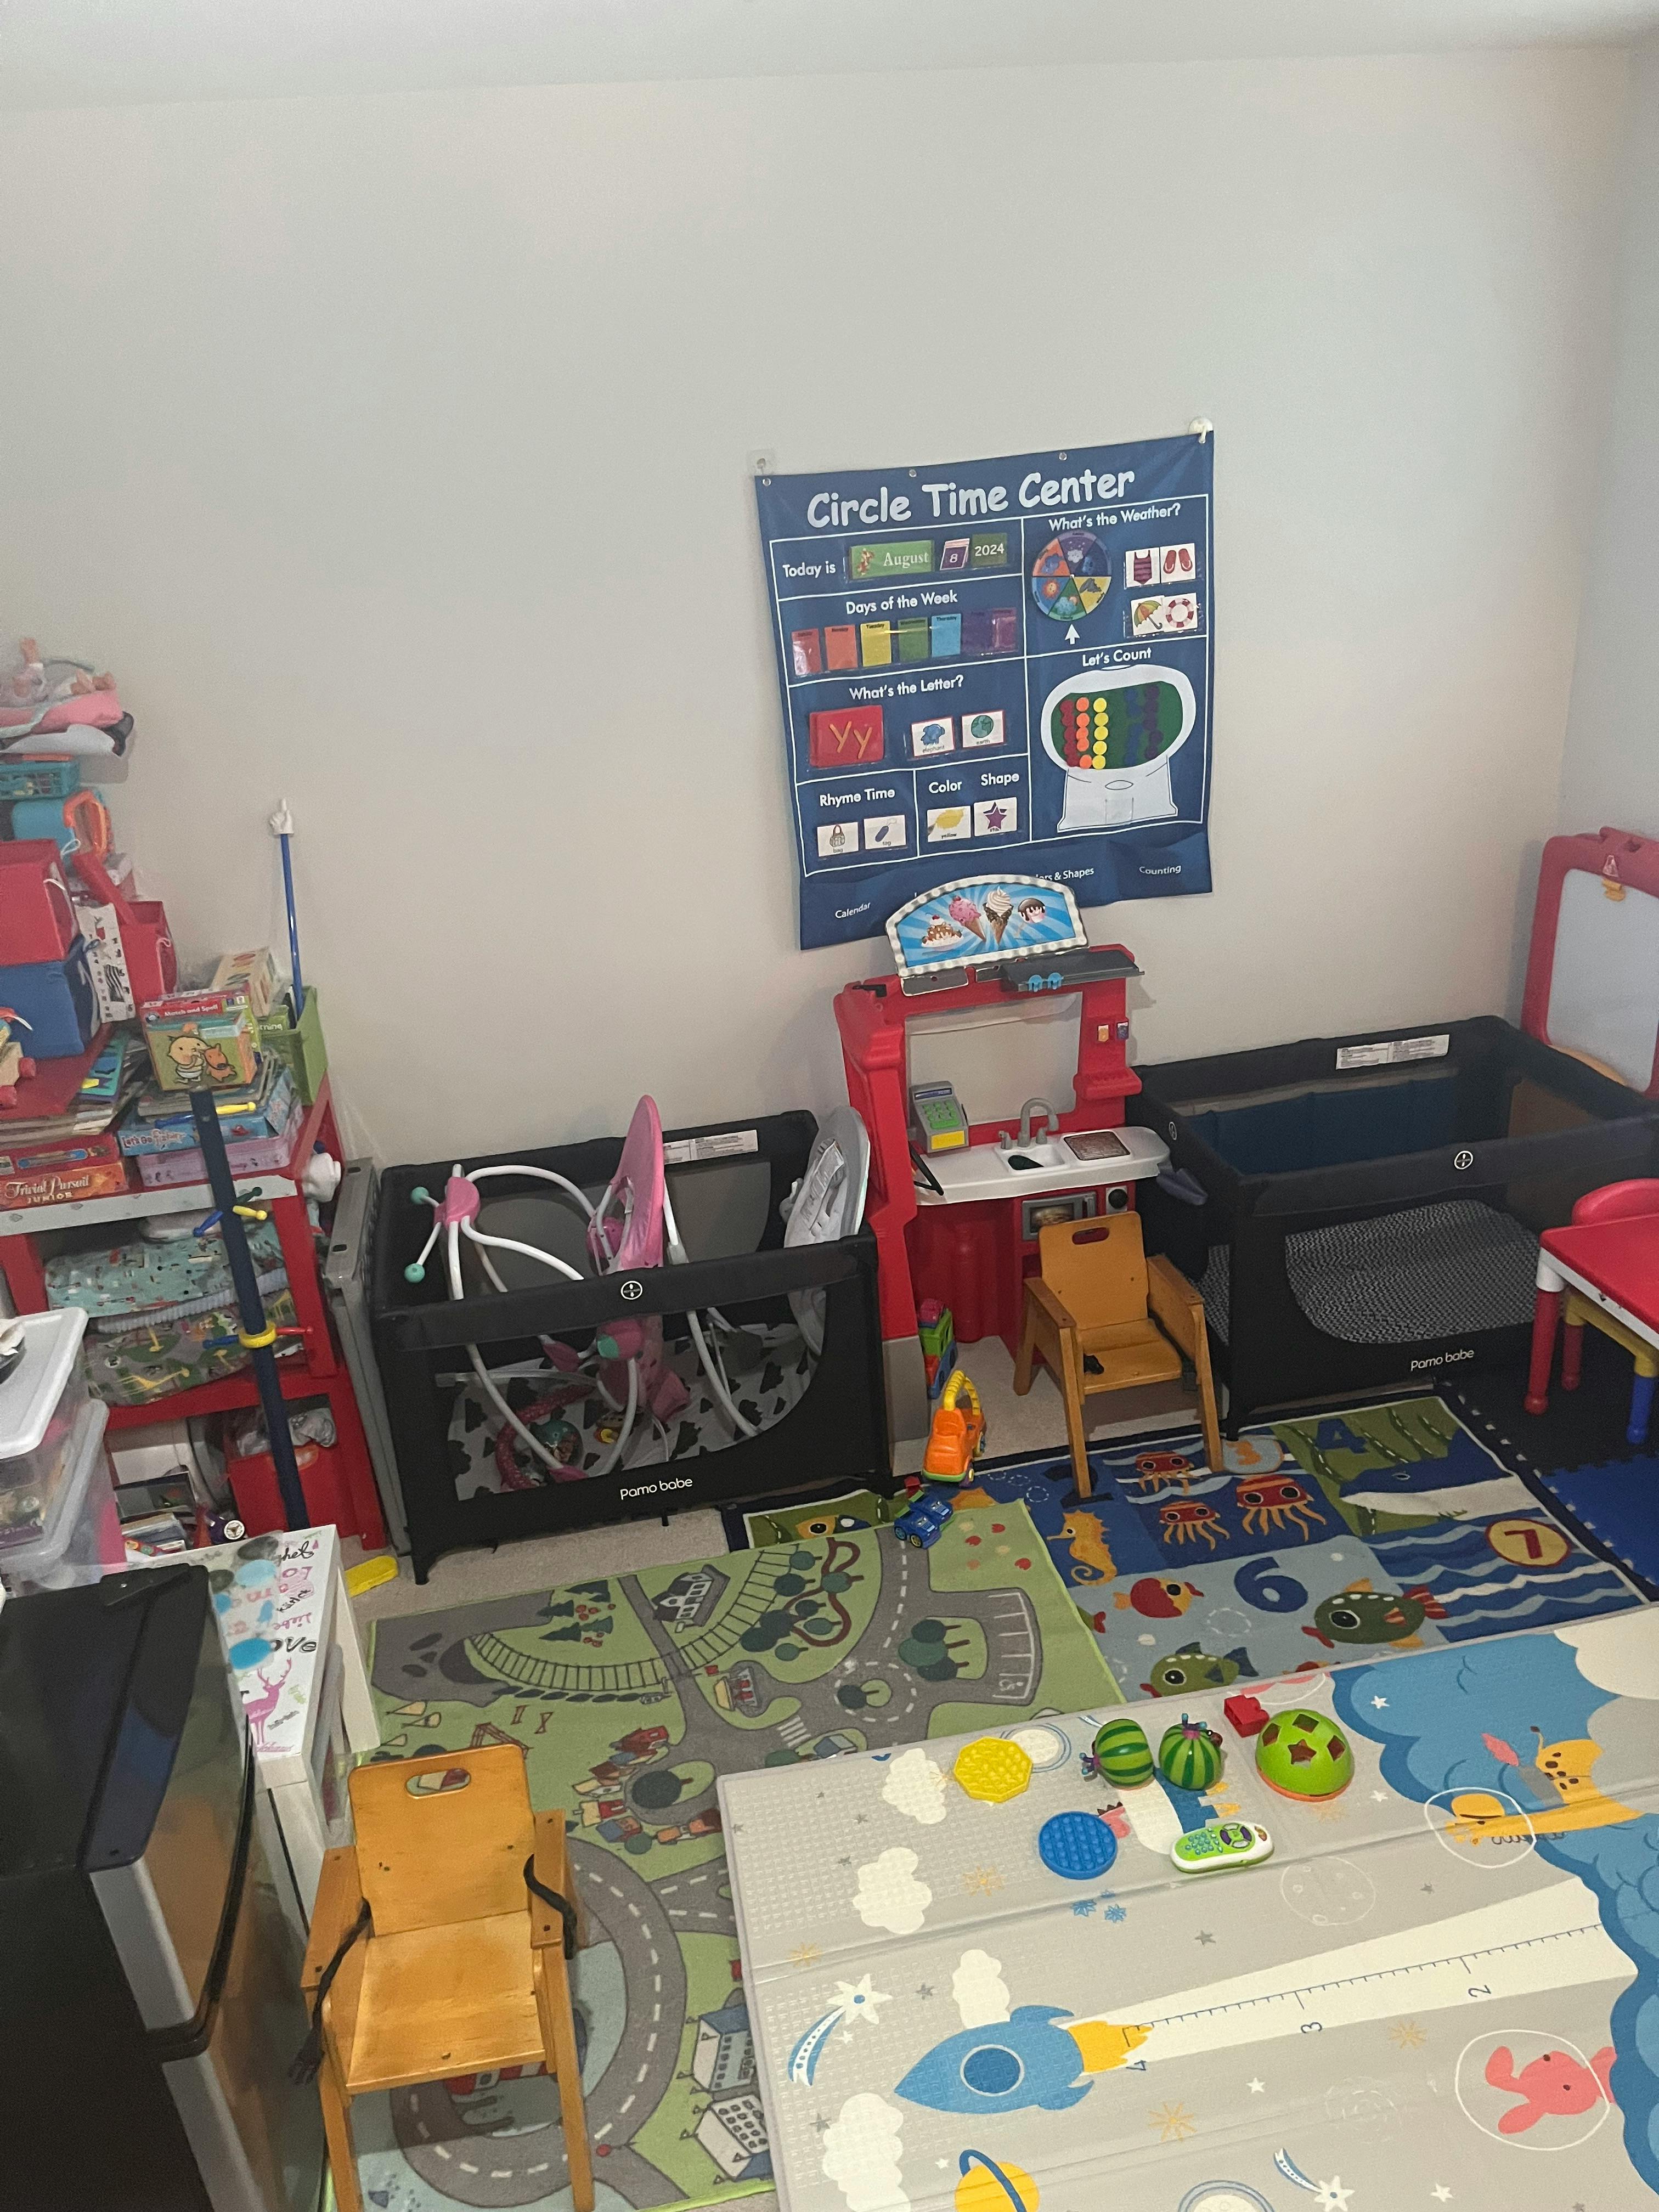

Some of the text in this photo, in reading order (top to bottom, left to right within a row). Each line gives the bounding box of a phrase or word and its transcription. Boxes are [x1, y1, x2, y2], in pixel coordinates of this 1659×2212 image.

[807, 469, 1135, 528] Circle Time Center
[1049, 503, 1181, 531] What's the Weather?
[782, 543, 1005, 578] Today is August 8 2024
[846, 590, 958, 616] Days of the Week
[1082, 648, 1152, 667] Let's Count
[849, 675, 964, 701] What's the Letter?
[829, 721, 873, 760] Yy
[923, 745, 945, 753] elephant
[928, 780, 962, 794] Color
[980, 773, 1020, 787] Shape
[820, 788, 895, 808] Rhyme Time
[1054, 872, 1062, 881] &
[1063, 868, 1094, 879] Shapes
[1138, 864, 1182, 876] Counting
[834, 901, 871, 919] Calendar
[4, 1175, 89, 1199] Trivial Pursuit
[27, 1191, 74, 1204] JUNIOR
[1445, 1349, 1475, 1363] babe
[659, 1477, 693, 1491] babe
[1504, 1528, 1543, 1559] 7
[1234, 1556, 1308, 1613] 6
[1468, 1984, 1492, 1997] 2
[1300, 2021, 1323, 2034] 3
[1125, 2059, 1147, 2071] 4
